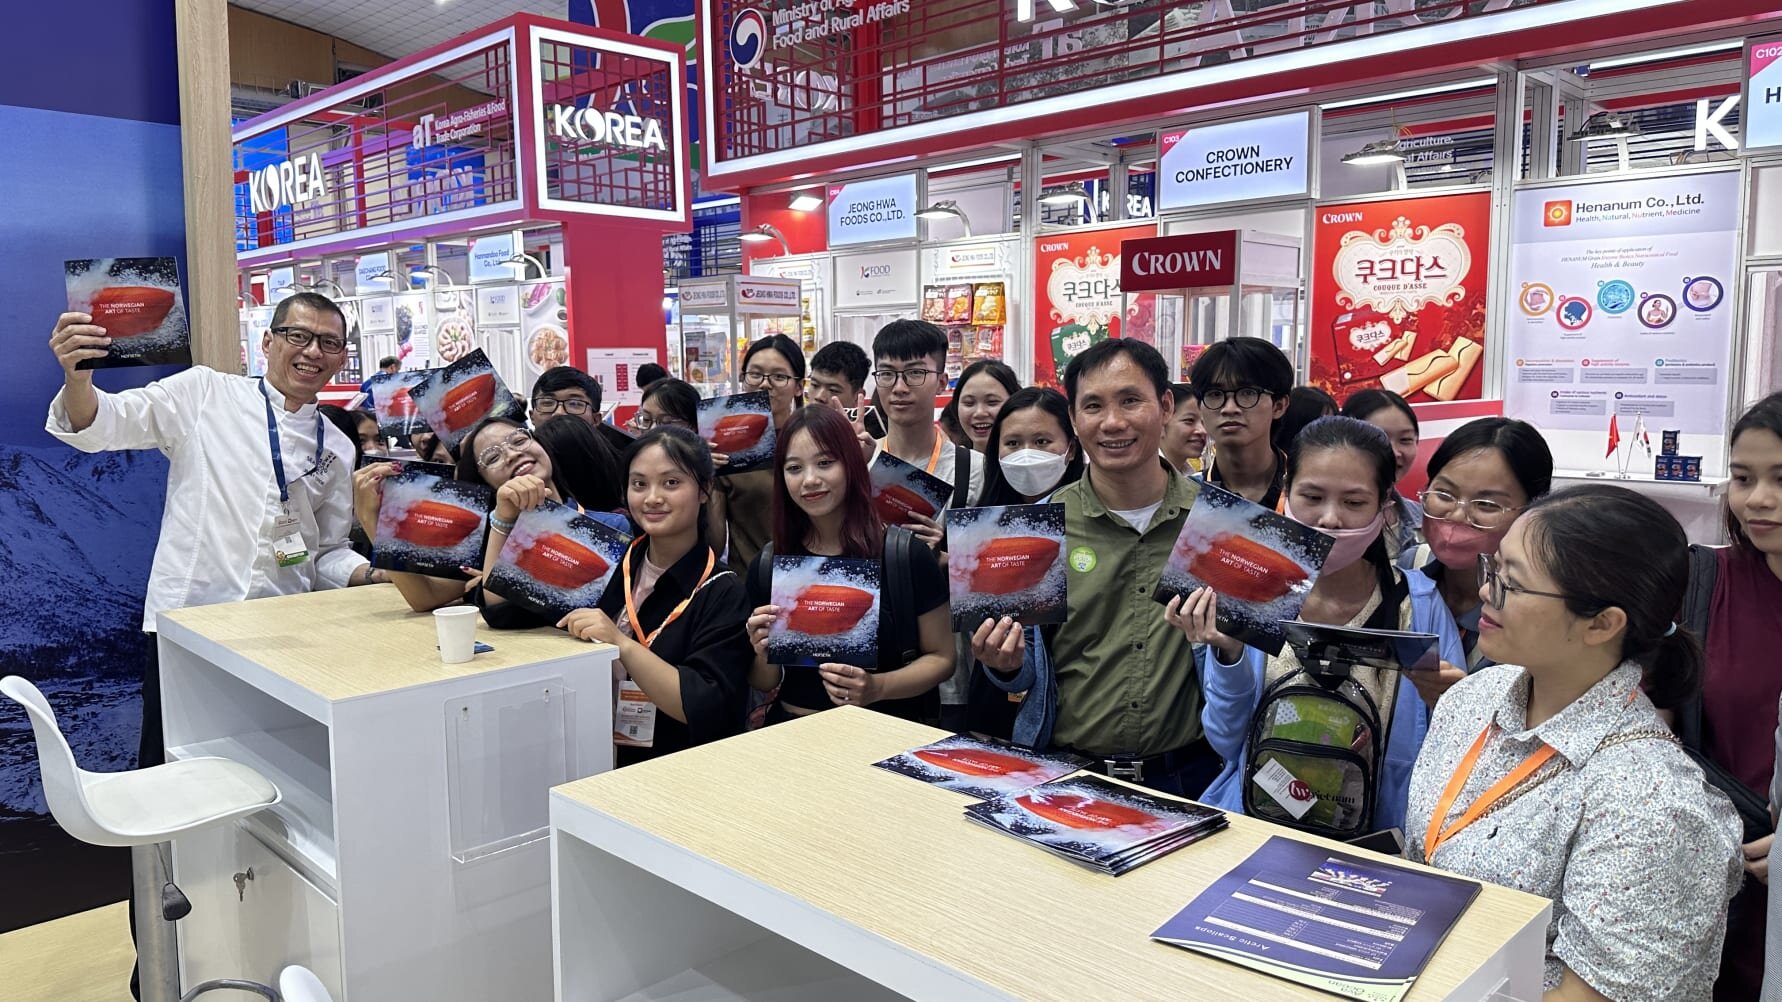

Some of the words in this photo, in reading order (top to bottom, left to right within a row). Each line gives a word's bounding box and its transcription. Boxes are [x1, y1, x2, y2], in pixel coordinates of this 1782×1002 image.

[772, 1, 821, 26] Ministry
[772, 29, 802, 50] Food
[805, 15, 828, 40] and
[832, 9, 864, 33] Rural
[866, 0, 910, 24] Affairs
[412, 113, 435, 150] aT
[436, 128, 450, 144] Trade
[450, 122, 482, 142] Corporation
[554, 104, 666, 150] KOREA
[1164, 134, 1180, 144] C103
[1206, 144, 1260, 164] CROWN
[1416, 150, 1452, 163] Affairs
[1175, 156, 1294, 184] CONFECTIONERY
[248, 152, 326, 213] KOREA
[848, 200, 874, 214] JEONG
[876, 198, 896, 210] HWA
[1576, 200, 1642, 213] Henanum
[1666, 208, 1701, 216] Medicine
[840, 213, 868, 226] FOODS
[1322, 212, 1362, 224] CROWN
[1040, 242, 1068, 252] CROWN
[1131, 249, 1222, 276] CROWN
[1354, 256, 1448, 284] 쿠크다스
[1590, 261, 1613, 269] Health
[1622, 260, 1645, 268] Beauty
[1356, 330, 1386, 344] 쿠크다스
[550, 548, 580, 566] NORWEGIAN
[1219, 548, 1231, 558] THE
[1230, 554, 1269, 574] NORWEGIAN
[1220, 558, 1234, 566] ART
[1244, 566, 1260, 578] TASTE
[1194, 926, 1237, 941] Scallops
[1238, 938, 1270, 950] Arctic
